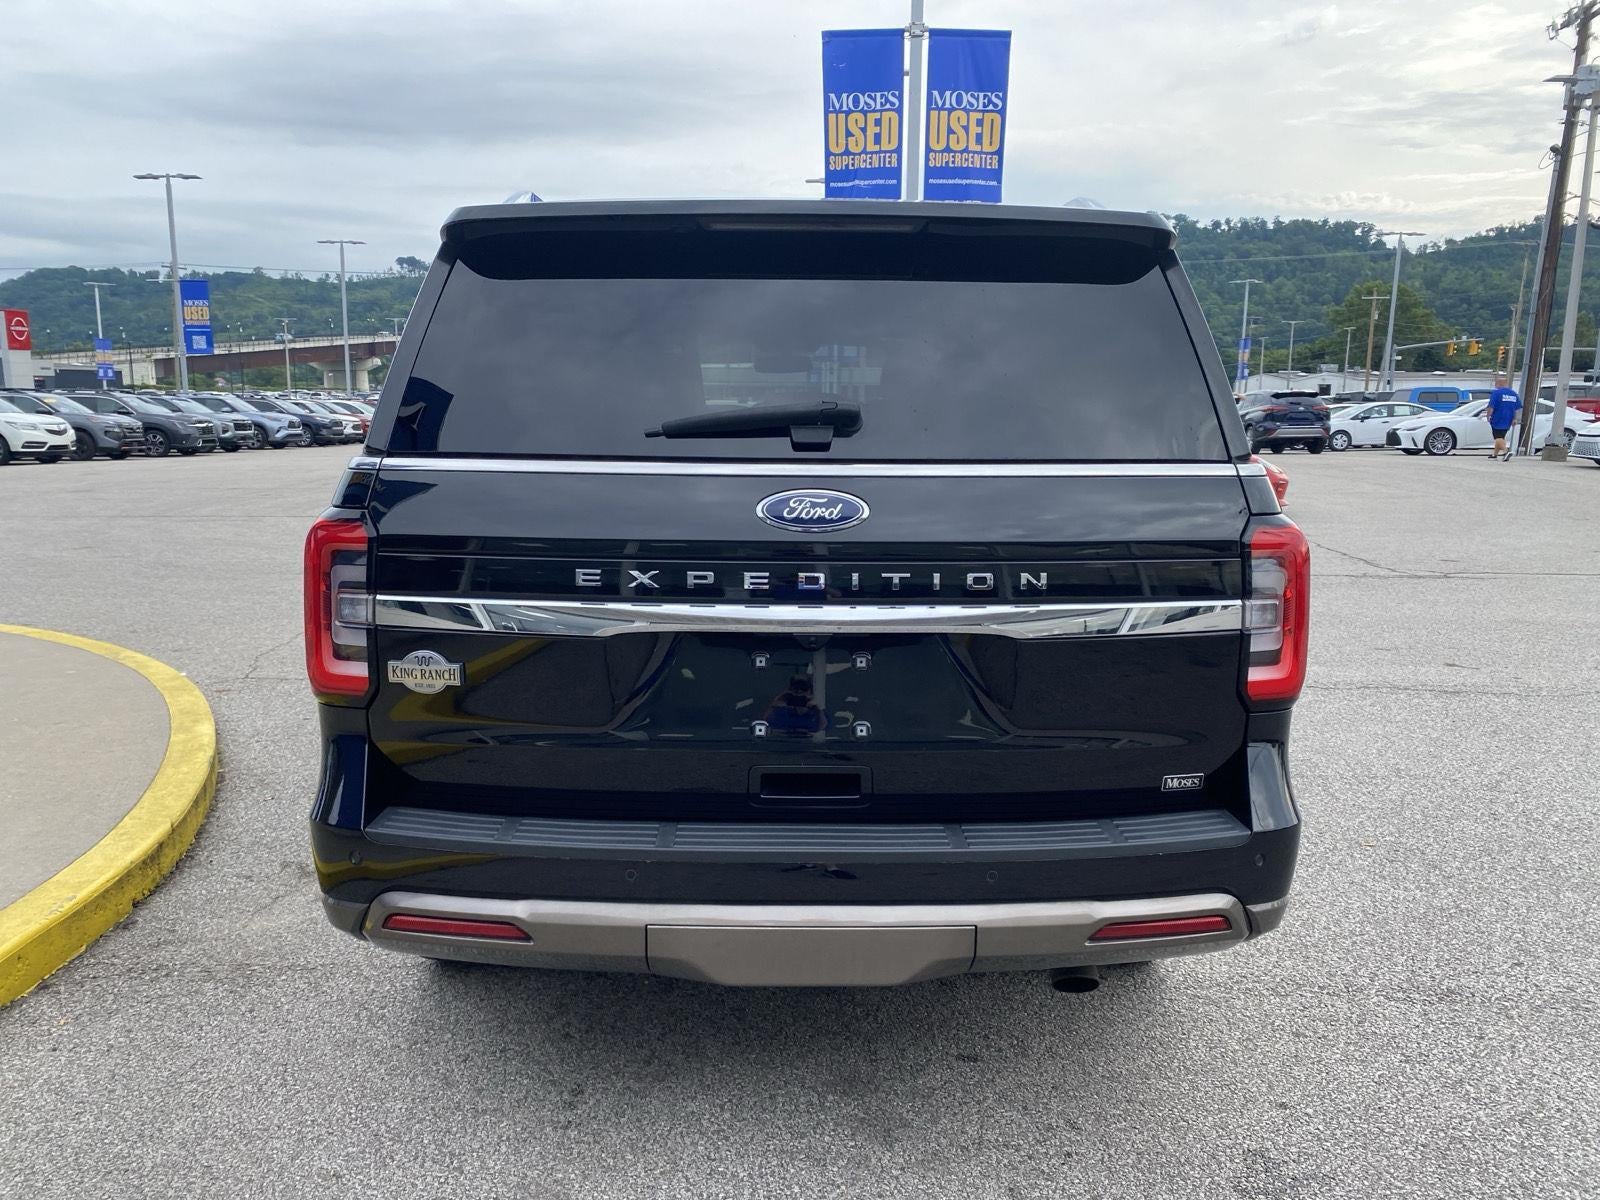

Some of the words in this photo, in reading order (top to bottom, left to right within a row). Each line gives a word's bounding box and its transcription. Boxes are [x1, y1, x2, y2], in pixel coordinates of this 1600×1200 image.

[828, 91, 899, 111] MOSES
[931, 91, 1003, 110] MOSES
[828, 111, 899, 153] USED
[929, 110, 1001, 152] USED
[829, 153, 898, 170] SUPERCENTER
[929, 152, 999, 169] SUPERCENTER
[184, 306, 209, 320] USED
[783, 498, 842, 522] Ford
[575, 568, 1048, 591] EXPEDITION
[391, 665, 418, 680] KING
[420, 668, 456, 681] RANCH
[1166, 778, 1200, 789] MOSES
